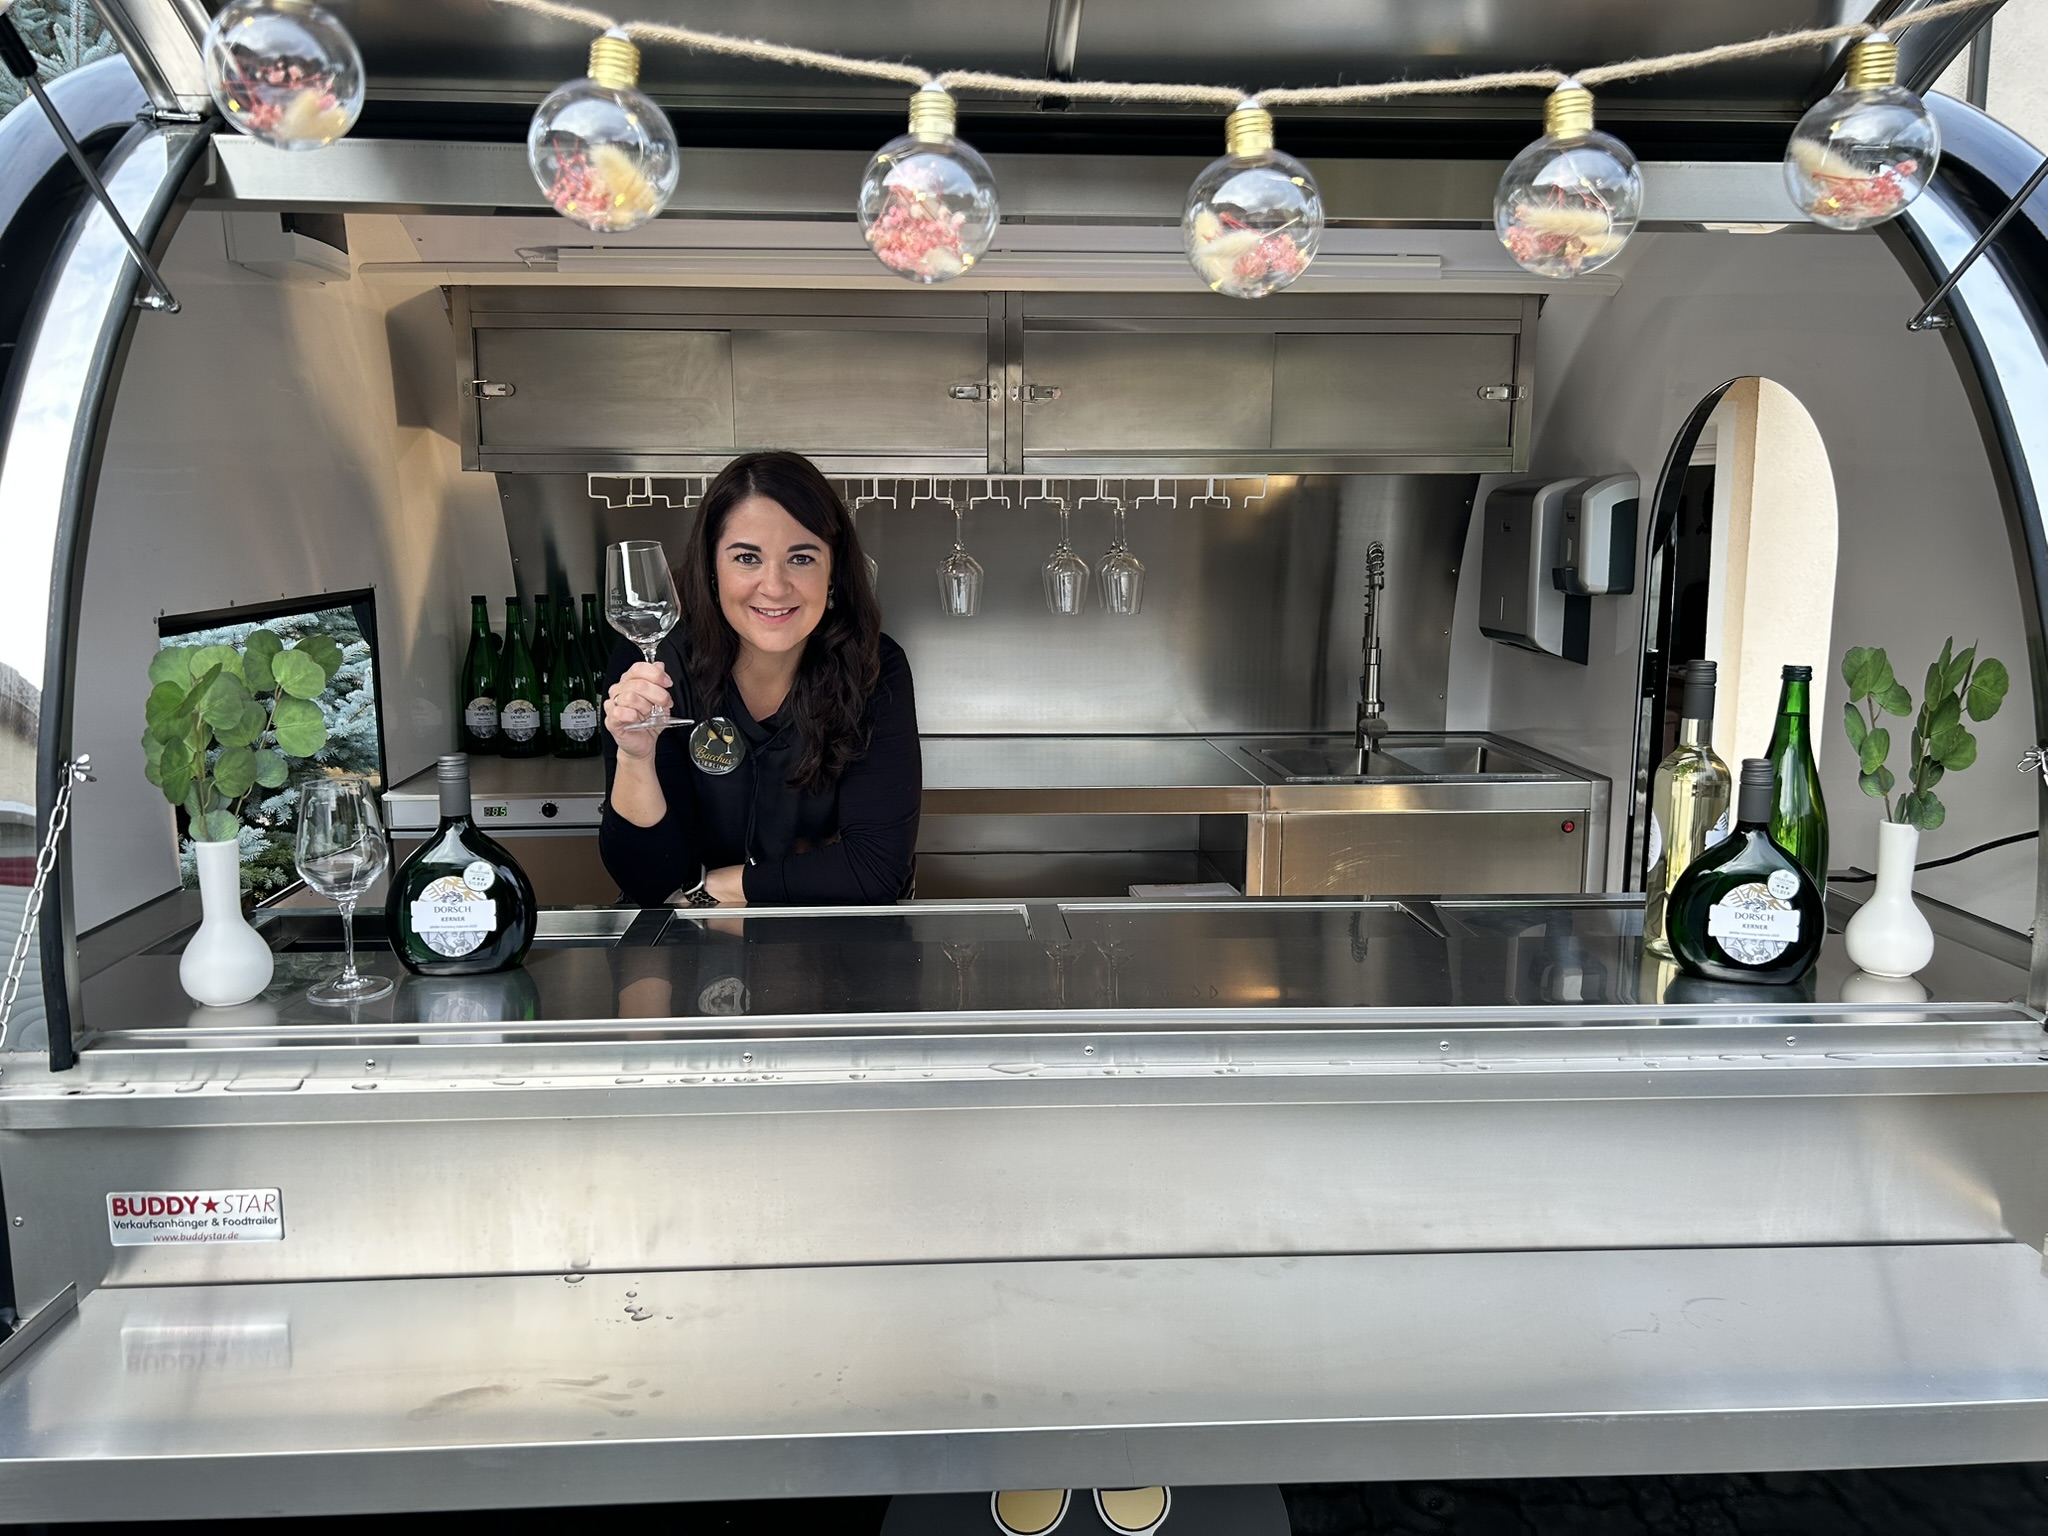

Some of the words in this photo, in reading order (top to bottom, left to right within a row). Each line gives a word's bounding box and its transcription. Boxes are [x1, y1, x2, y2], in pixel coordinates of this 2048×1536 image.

[695, 746, 732, 765] Bacchus
[434, 905, 472, 913] DORSCH
[1734, 912, 1775, 922] DORSCH
[112, 1195, 200, 1217] BUDDY
[223, 1193, 276, 1214] STAR
[113, 1218, 208, 1231] Verkaufsanhänger
[211, 1218, 220, 1227] &
[223, 1216, 278, 1226] Foodtrailer
[153, 1231, 239, 1242] www.buddystar.de
